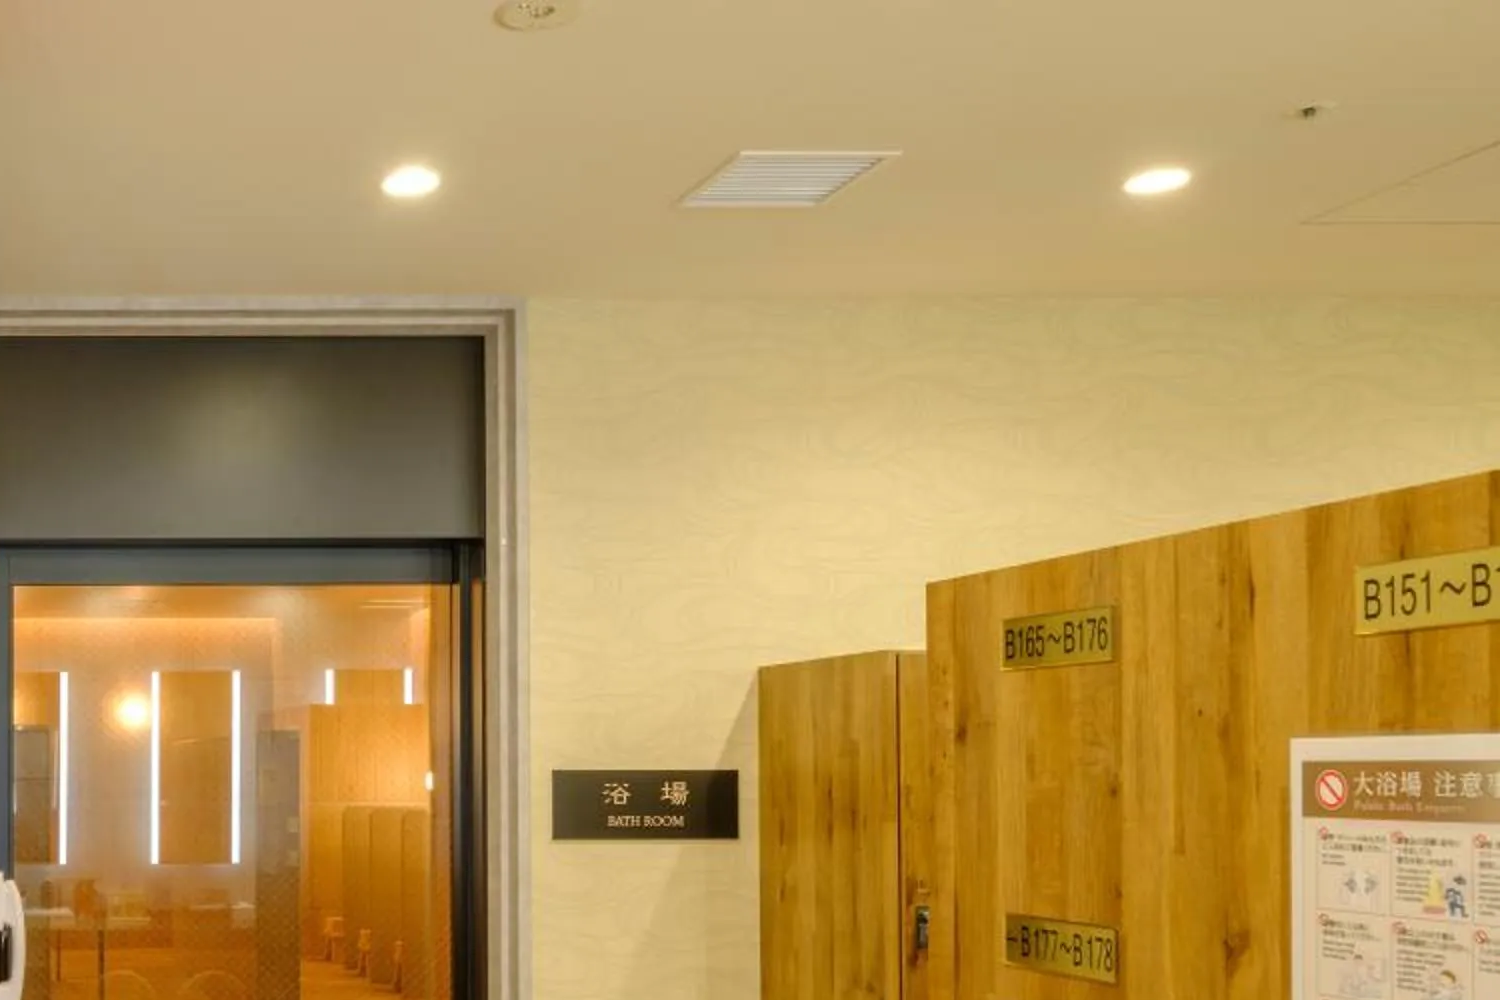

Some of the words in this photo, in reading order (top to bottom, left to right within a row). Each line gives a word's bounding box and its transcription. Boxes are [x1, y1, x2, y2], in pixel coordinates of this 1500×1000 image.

[1364, 563, 1500, 620] B151~B
[1005, 617, 1109, 660] B165~B176
[602, 781, 690, 805] 浴場
[1354, 771, 1422, 798] 大浴場
[607, 815, 640, 827] BATH
[644, 815, 685, 827] ROOM
